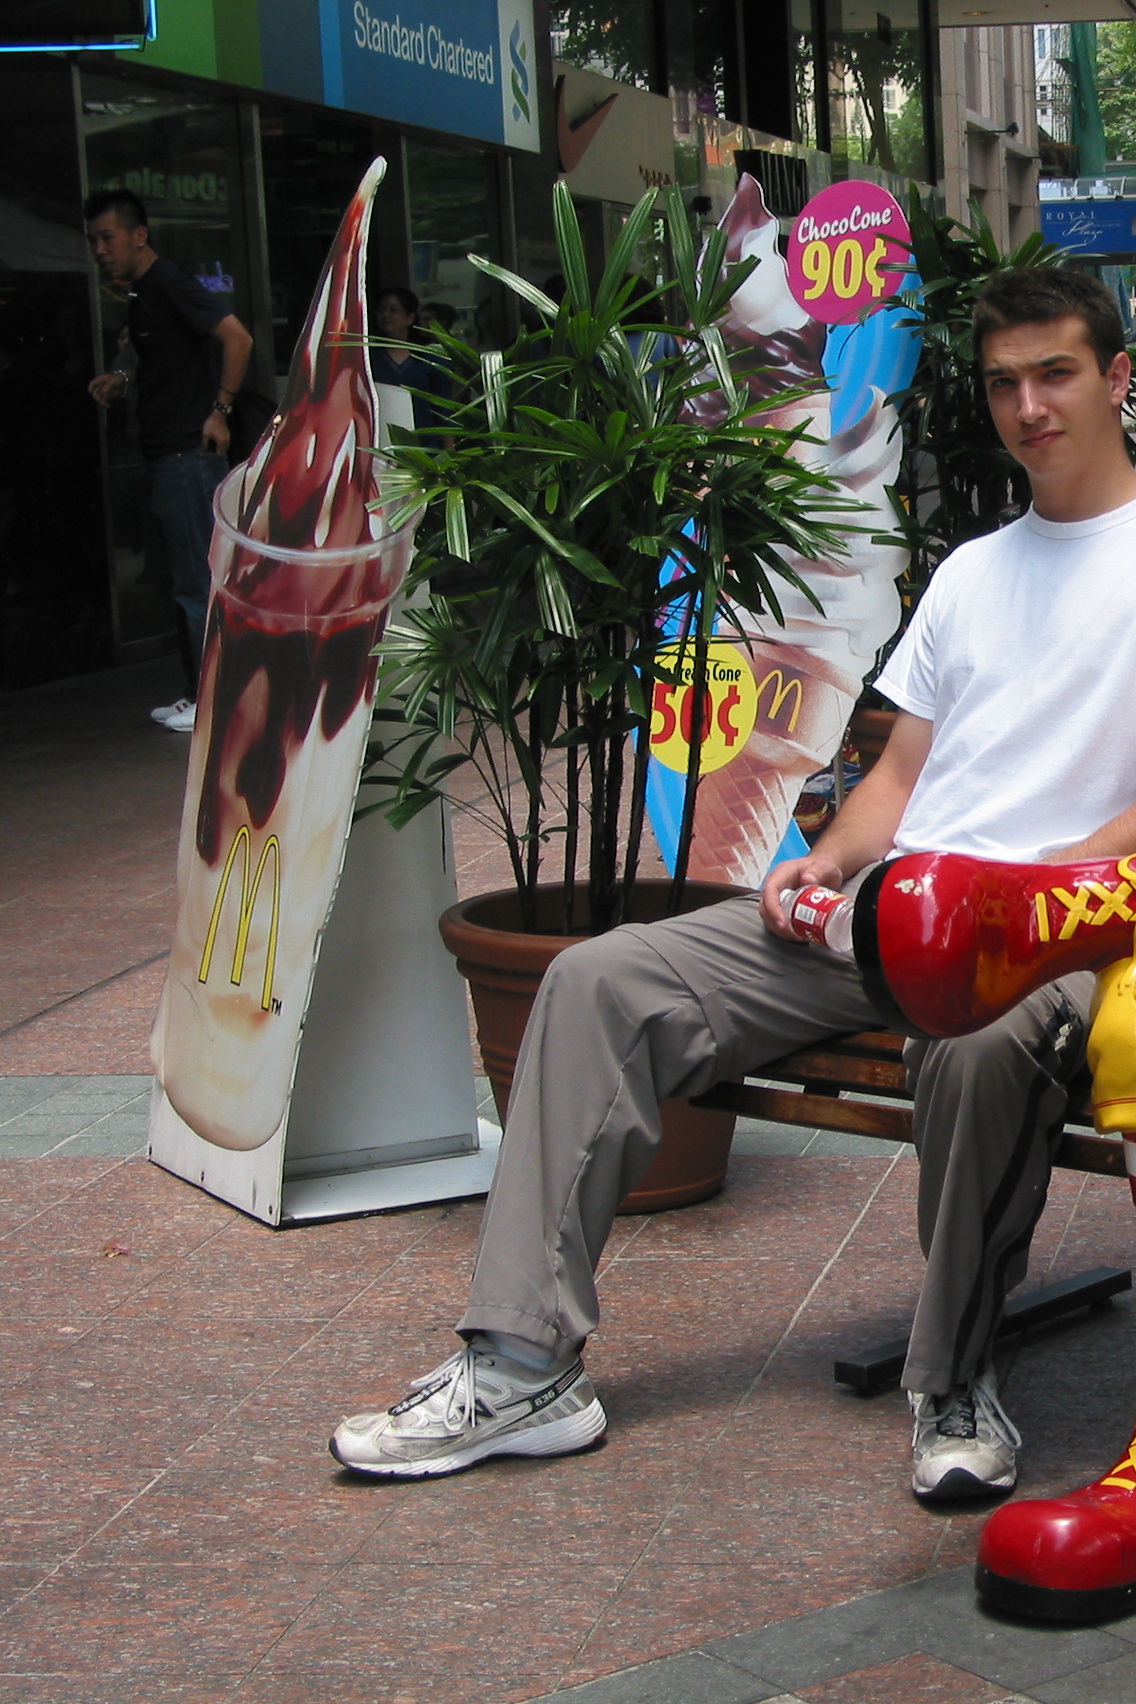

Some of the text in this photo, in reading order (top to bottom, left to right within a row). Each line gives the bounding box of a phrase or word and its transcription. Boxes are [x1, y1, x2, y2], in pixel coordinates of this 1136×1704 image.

[353, 1, 494, 85] Standard Chartered
[797, 205, 892, 244] ChocoCone
[1045, 208, 1097, 220] ROYAL
[801, 237, 888, 300] 90¢
[713, 661, 741, 682] Cone
[650, 682, 741, 747] 50¢
